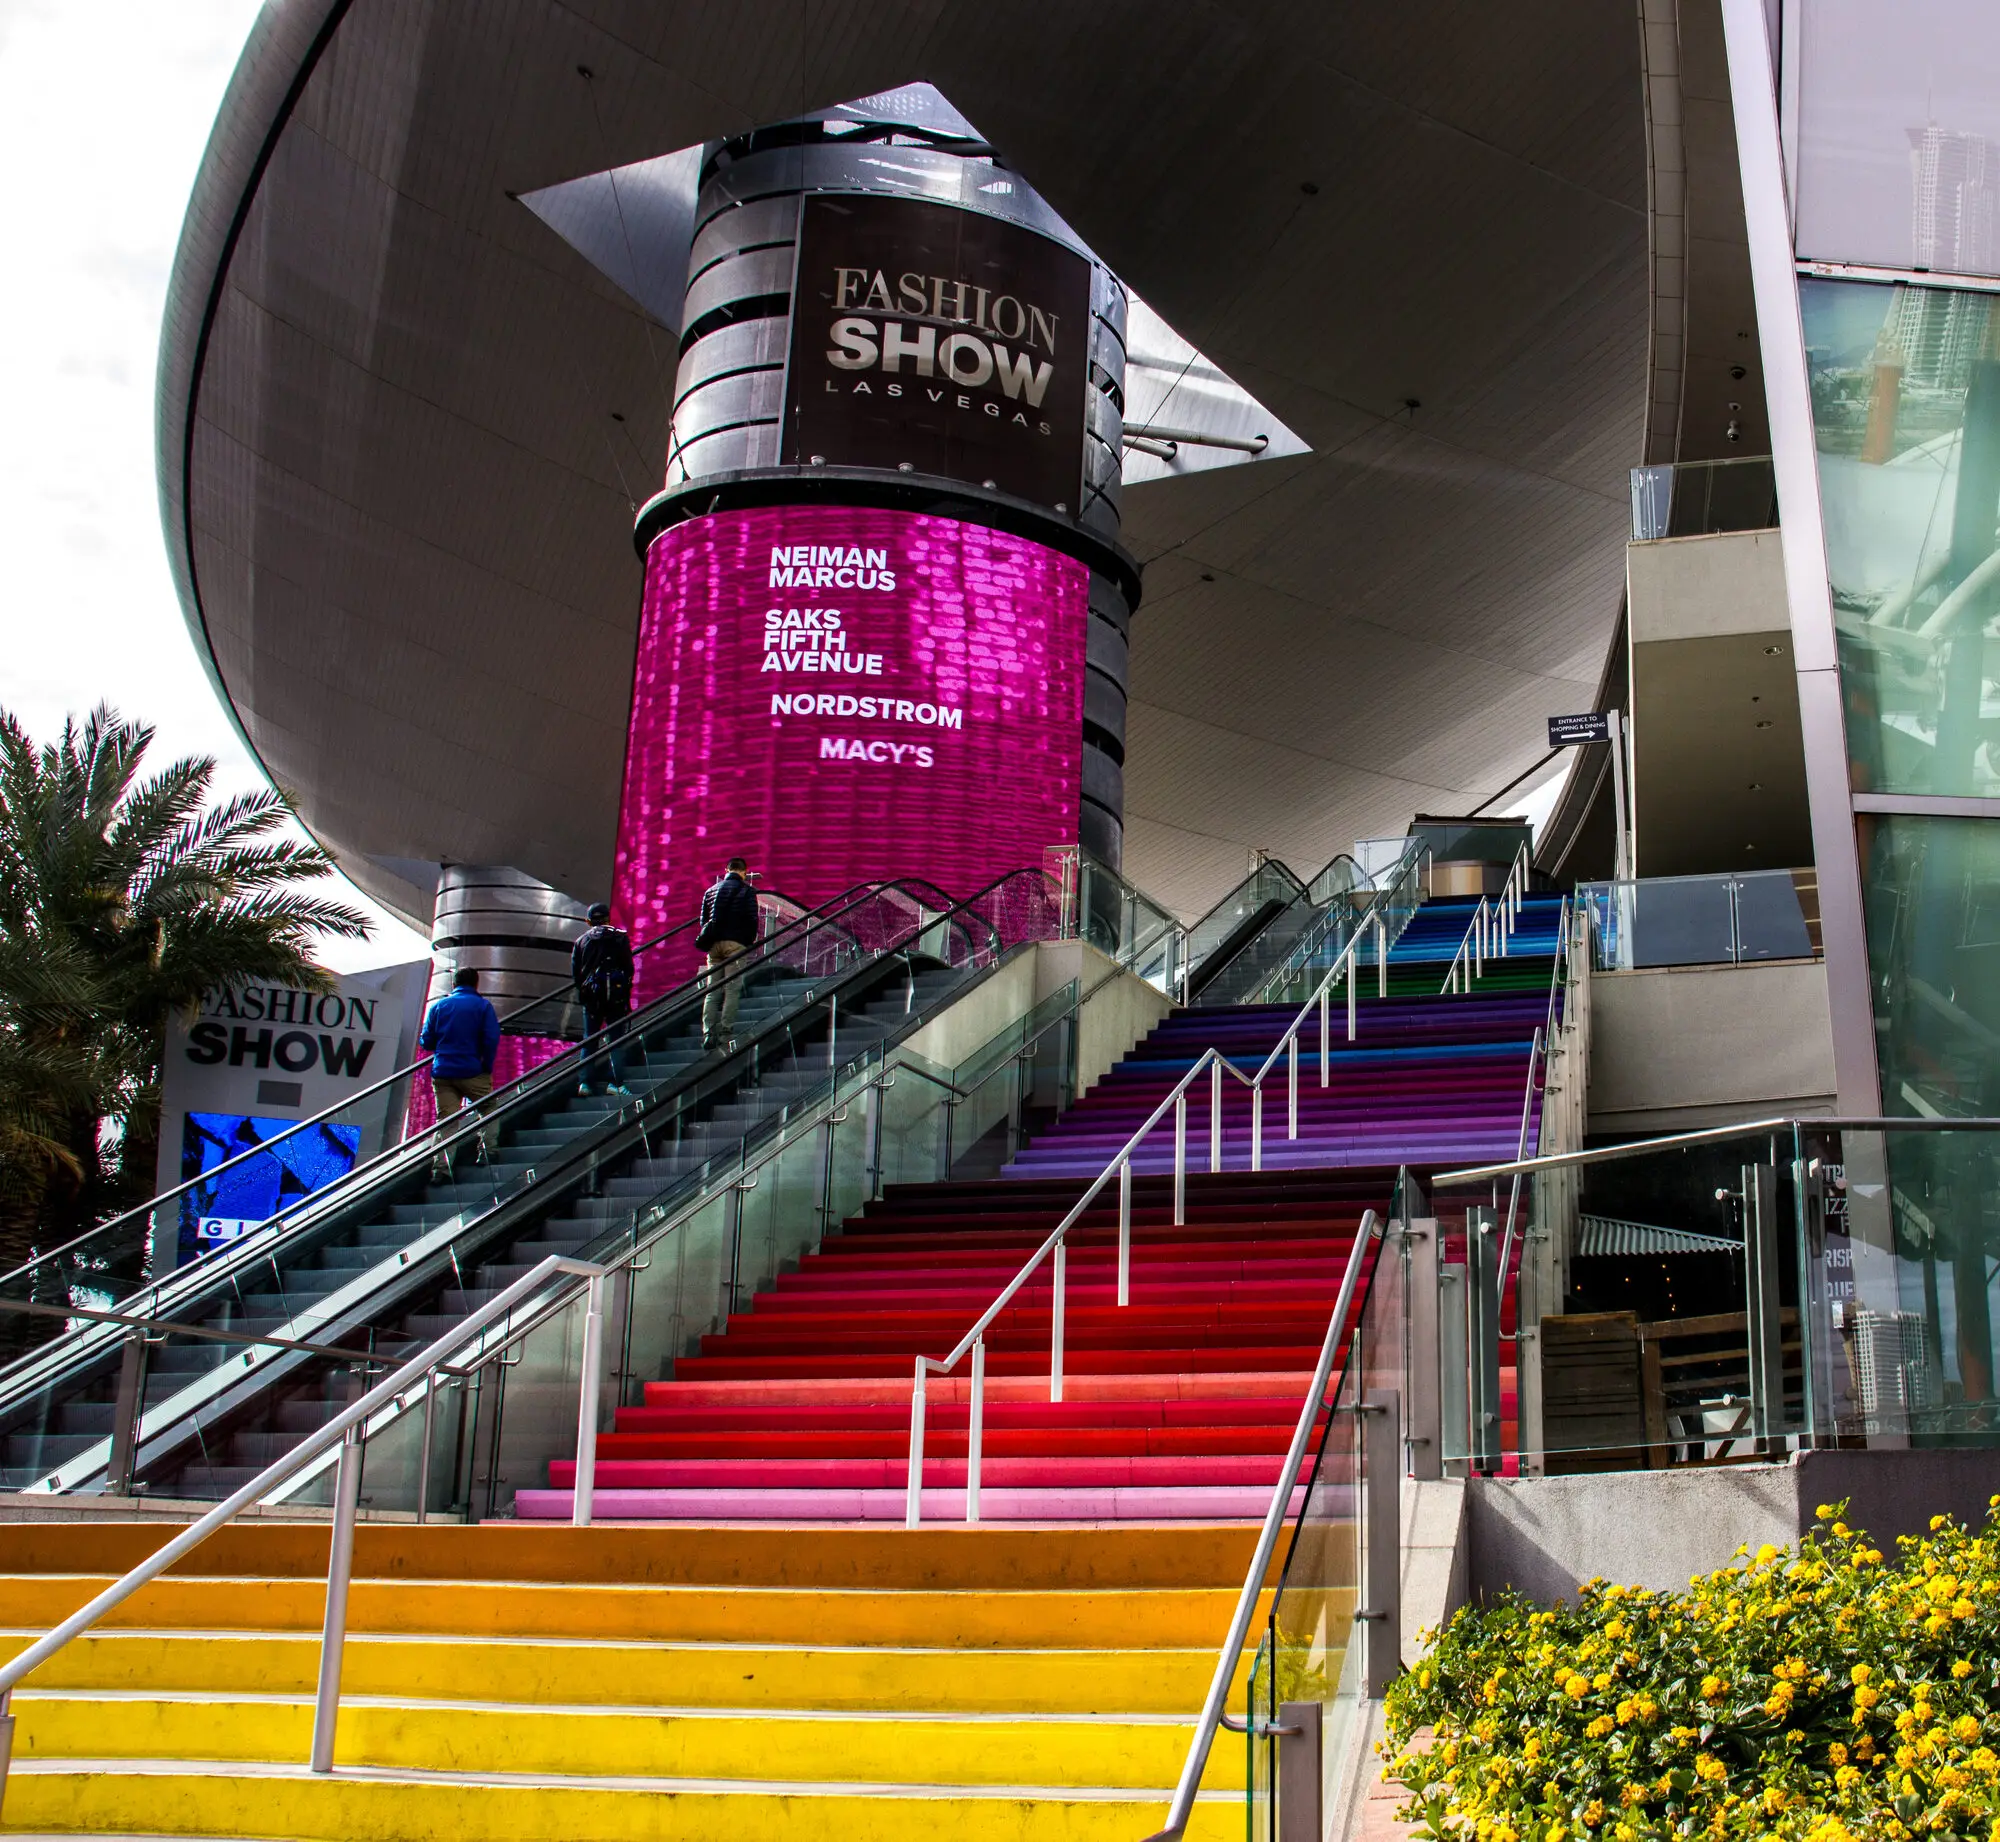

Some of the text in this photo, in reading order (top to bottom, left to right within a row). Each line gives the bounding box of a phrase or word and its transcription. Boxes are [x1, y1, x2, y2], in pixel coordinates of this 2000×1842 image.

[831, 267, 1060, 356] FASHION
[826, 317, 1054, 408] SHOW
[825, 379, 1052, 436] LAS VEGAS
[770, 546, 887, 569] NEIMAN
[768, 567, 896, 592] MARCUS
[764, 608, 841, 630] SAKS
[763, 630, 846, 651] FIFTH
[760, 651, 883, 675] AVENUE
[770, 694, 963, 730] NORDSTROM
[1558, 716, 1588, 724] ENTRANCE
[1550, 724, 1579, 732] SHOPPING
[819, 737, 935, 768] MACY'S
[185, 1022, 376, 1078] SHOW
